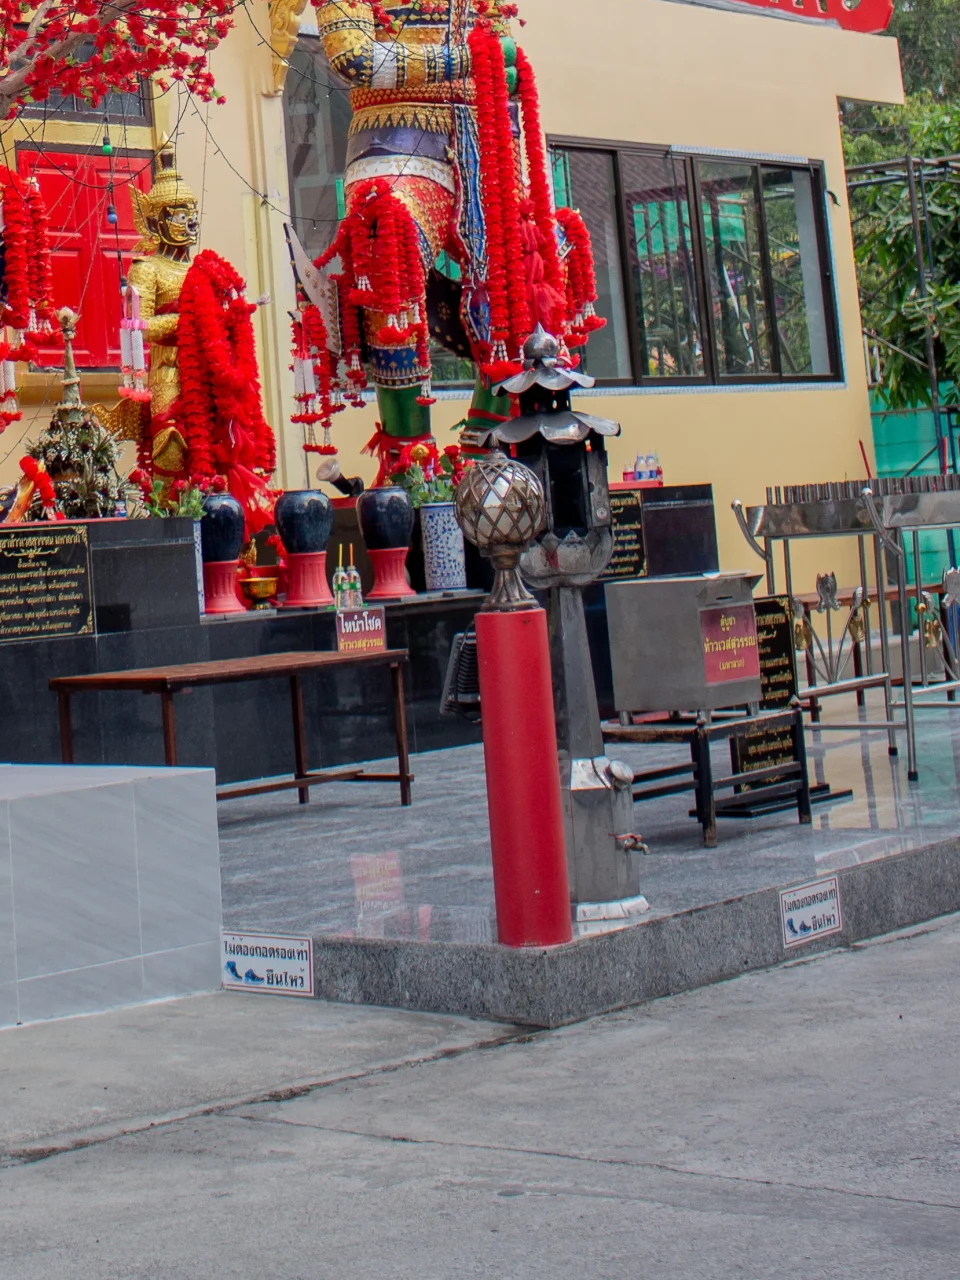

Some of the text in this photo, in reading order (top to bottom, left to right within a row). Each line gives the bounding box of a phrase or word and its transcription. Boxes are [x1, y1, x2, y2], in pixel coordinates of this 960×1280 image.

[338, 611, 381, 633] ไหนำโชค
[784, 882, 836, 913] ไม่ต้องถอดรองเท้า
[811, 906, 836, 930] ยืนไหว้
[224, 937, 308, 961] ไม่ต้องถอดรองเท้า
[266, 967, 305, 988] ยืนไหว้
